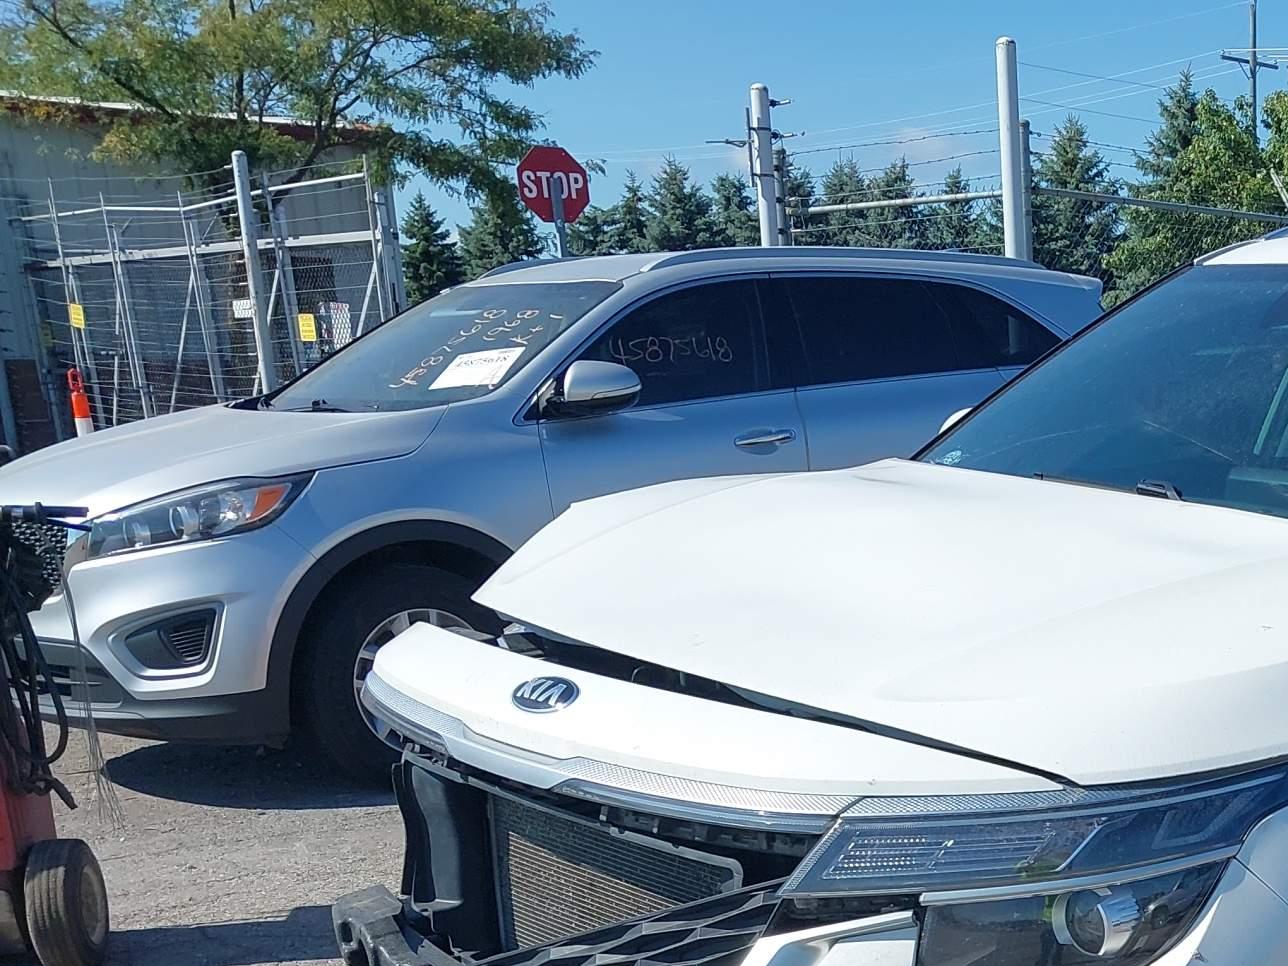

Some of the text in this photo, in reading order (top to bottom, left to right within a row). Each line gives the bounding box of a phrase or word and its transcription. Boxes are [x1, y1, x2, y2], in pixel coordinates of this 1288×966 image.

[522, 170, 583, 199] STOP
[609, 336, 733, 366] 45875618
[516, 679, 567, 706] KIA
